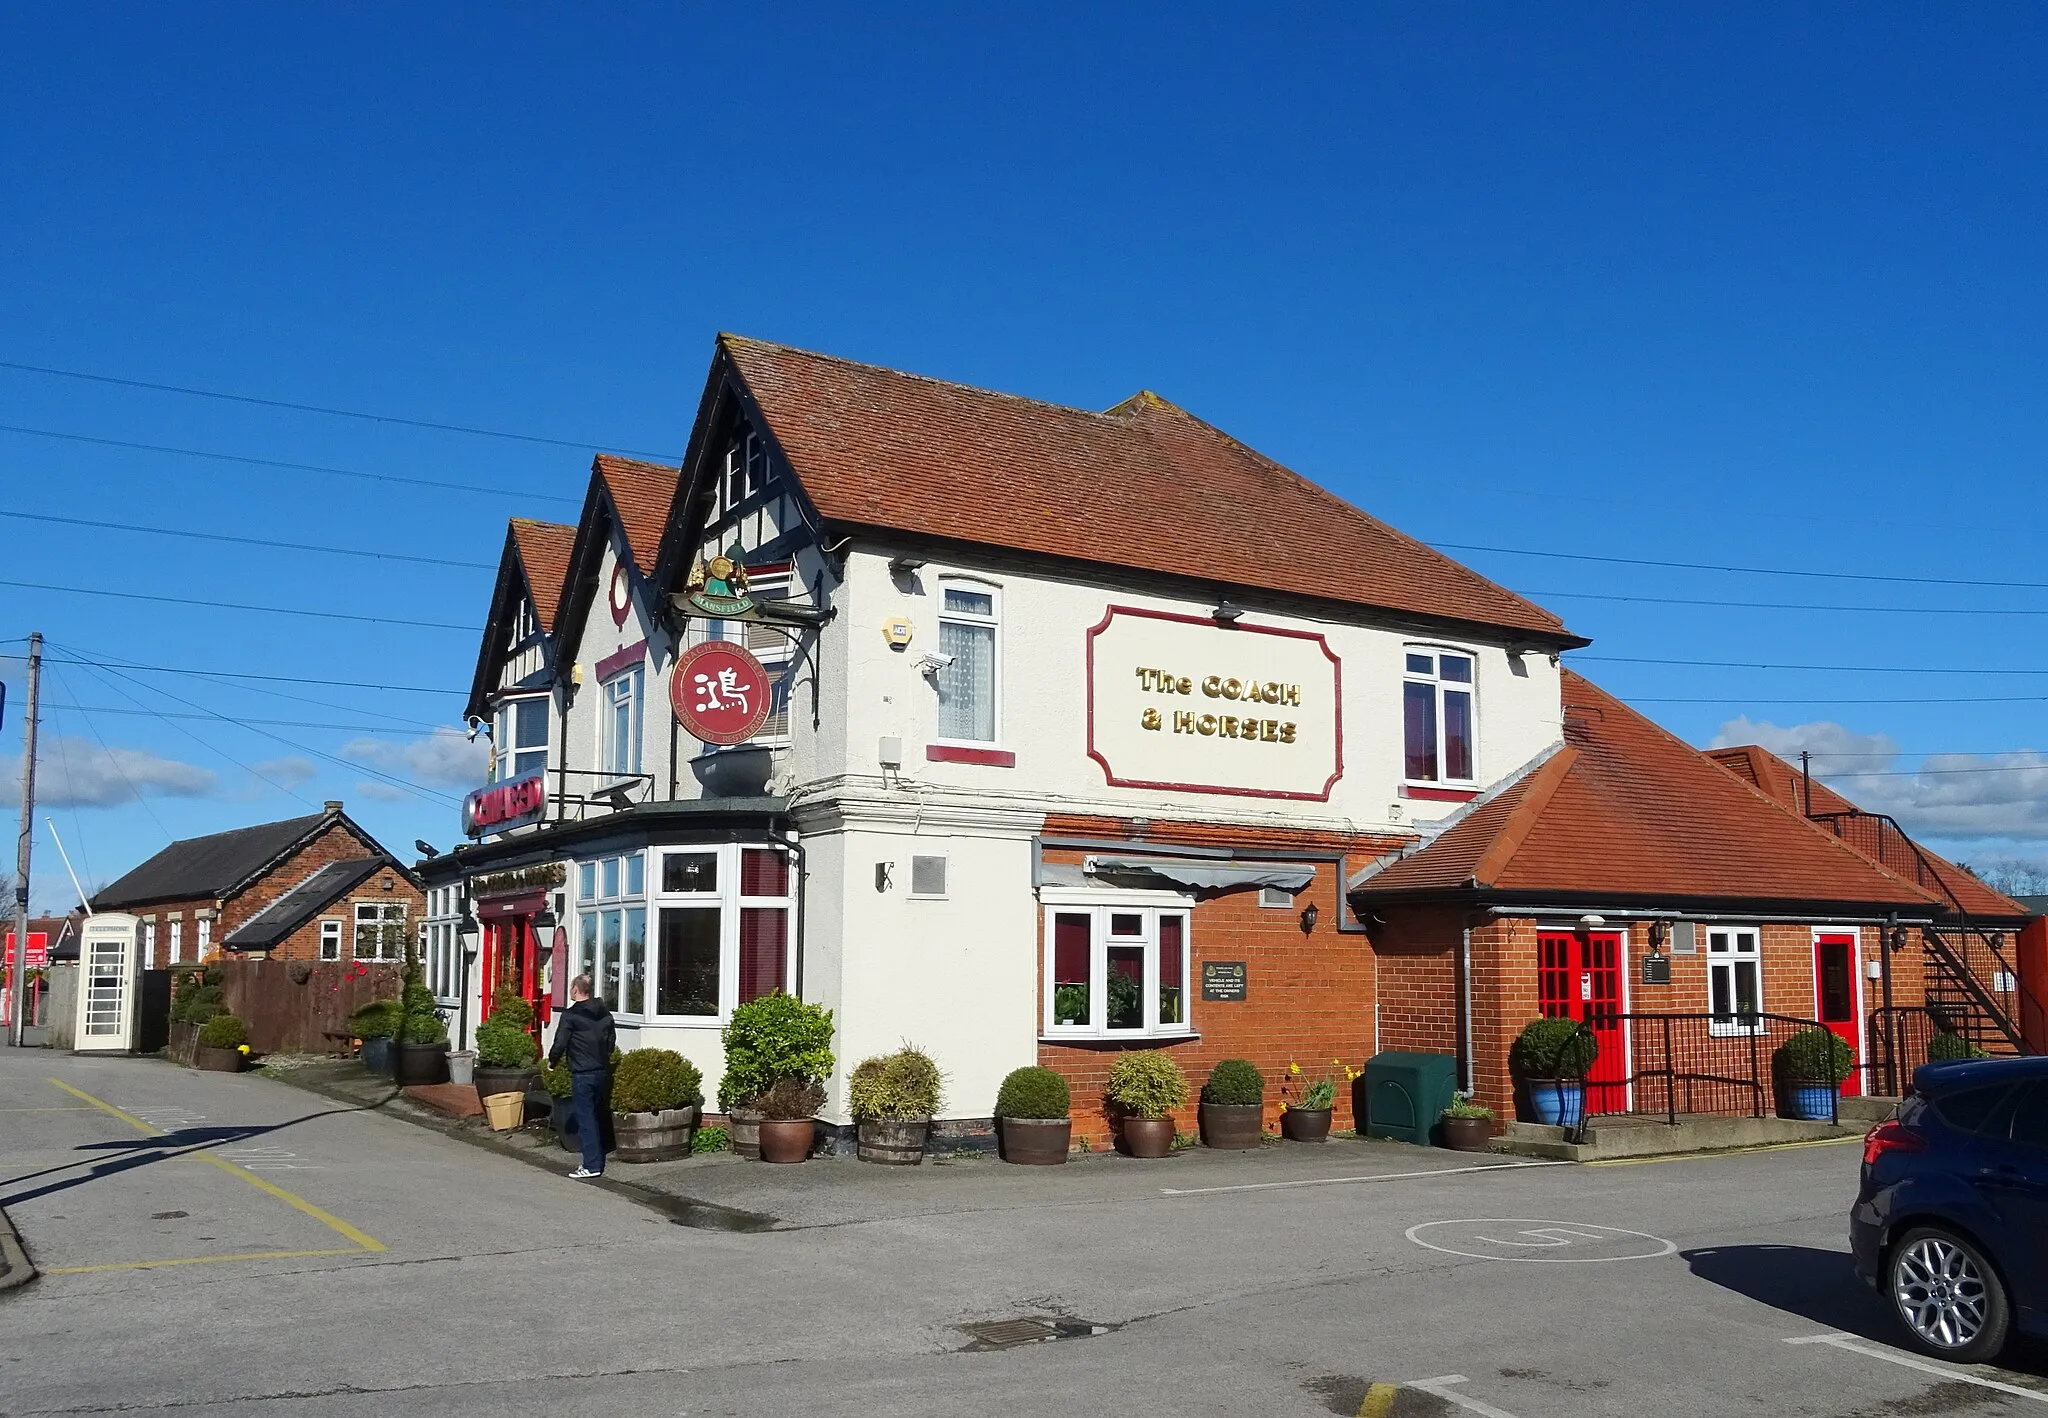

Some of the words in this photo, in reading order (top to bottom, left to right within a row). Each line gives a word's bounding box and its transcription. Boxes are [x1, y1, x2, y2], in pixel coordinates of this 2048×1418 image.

[694, 594, 749, 612] MANSFIELD
[678, 643, 712, 672] COACH
[727, 644, 765, 678] HORSES
[1135, 666, 1192, 695] The
[1201, 675, 1301, 707] COACH
[676, 702, 695, 729] CHINA
[697, 727, 714, 740] RED
[722, 709, 767, 742] RESTAURANT
[1141, 707, 1162, 731] &
[1173, 710, 1297, 744] HORSES
[1473, 1227, 1604, 1247] 5
